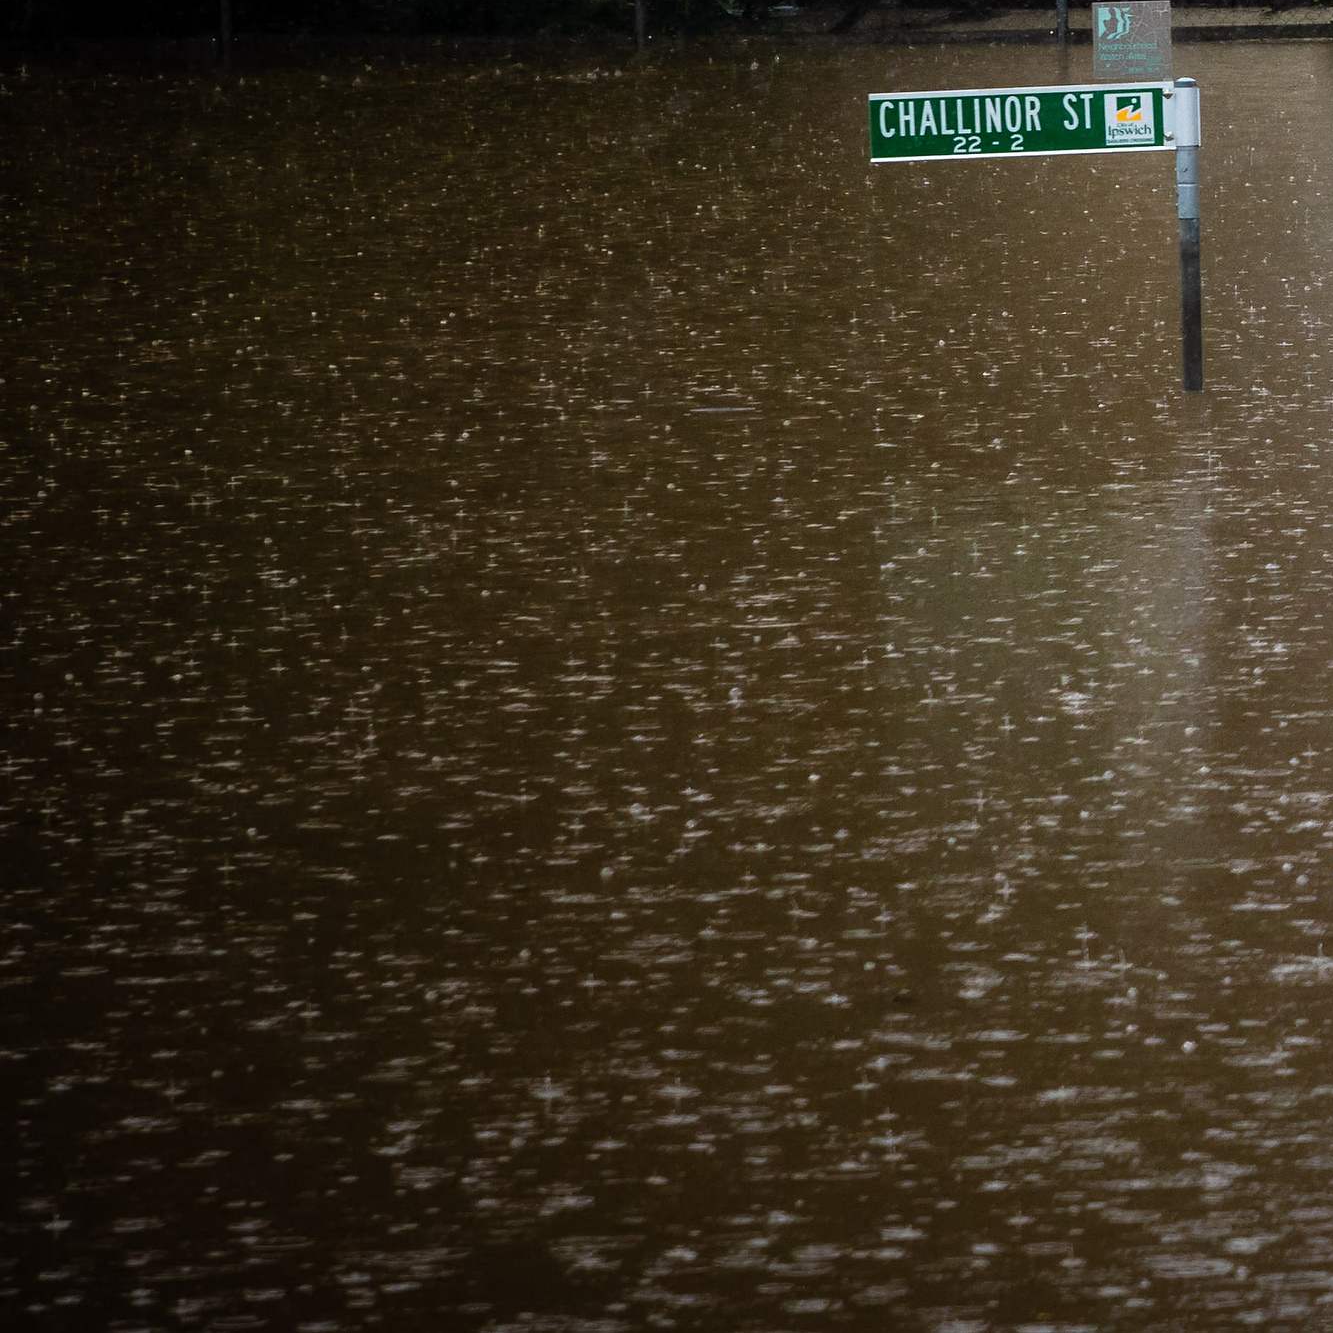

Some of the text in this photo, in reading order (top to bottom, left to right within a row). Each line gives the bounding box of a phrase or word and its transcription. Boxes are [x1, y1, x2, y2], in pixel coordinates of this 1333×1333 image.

[879, 93, 1094, 138] CHALLINOR ST
[1108, 124, 1152, 139] Ipswich
[953, 136, 982, 153] 22
[1010, 134, 1024, 151] 2
